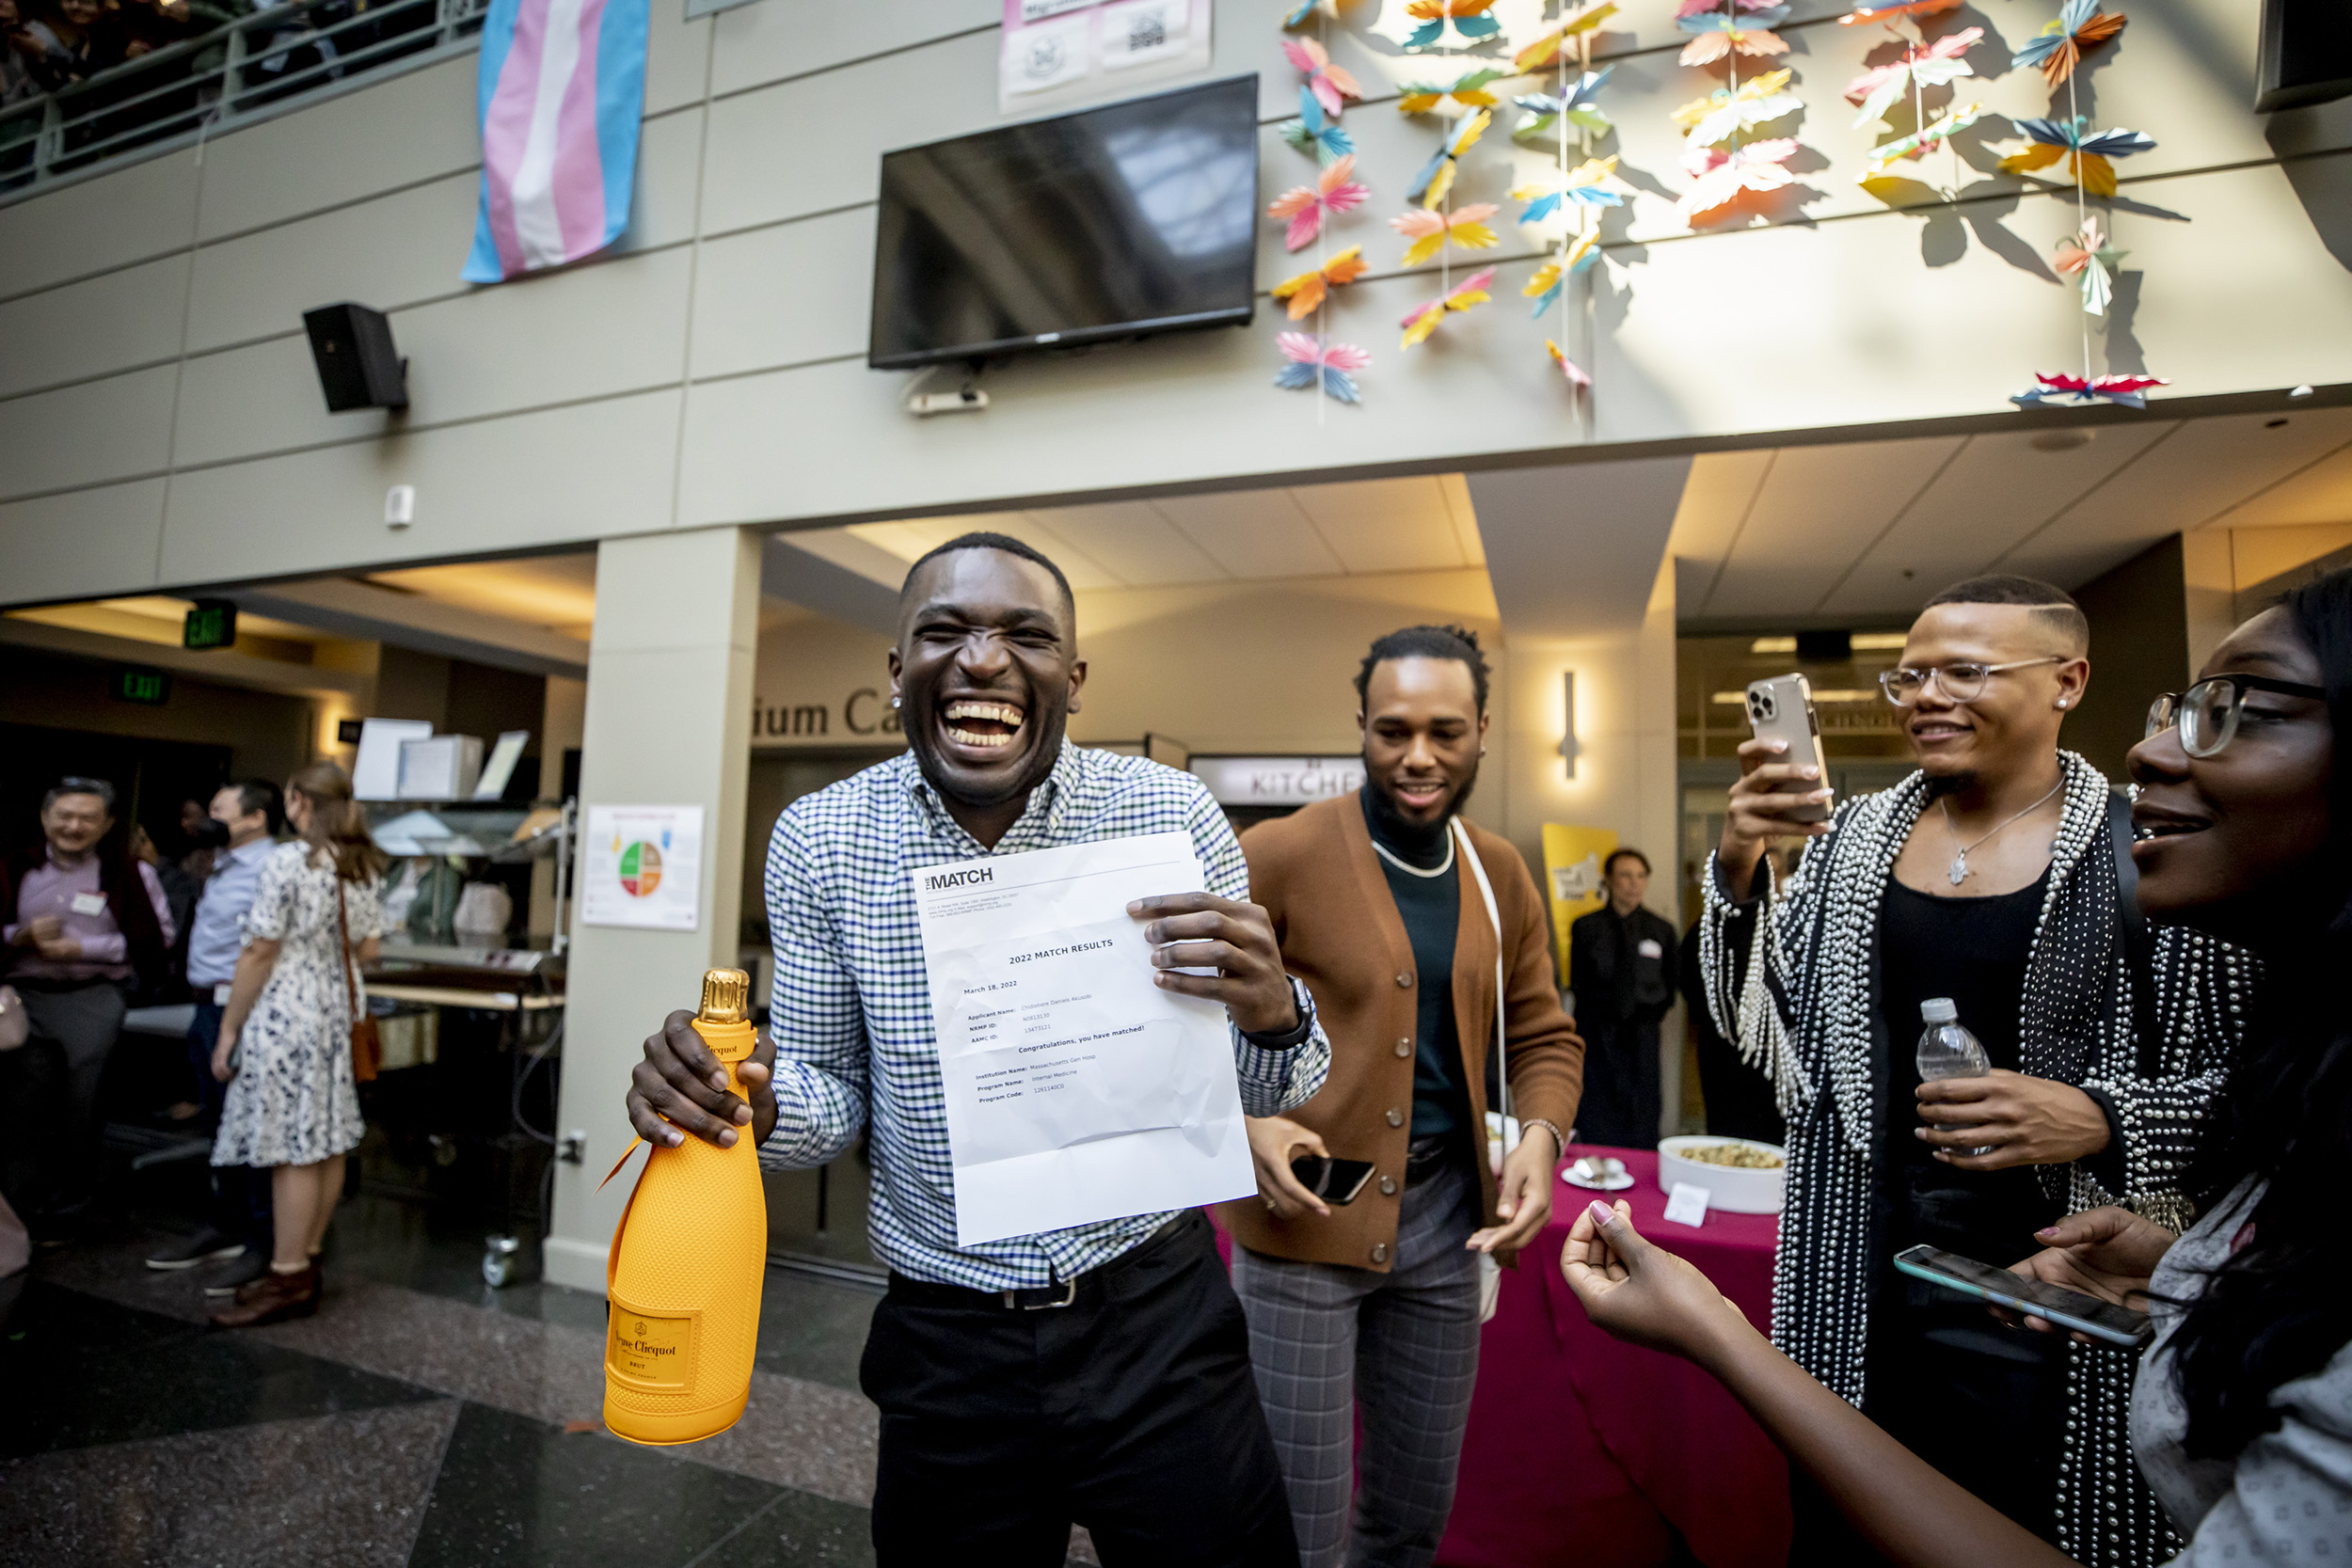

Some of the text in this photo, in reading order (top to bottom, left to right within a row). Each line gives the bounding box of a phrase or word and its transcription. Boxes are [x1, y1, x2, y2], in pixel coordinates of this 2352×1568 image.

[754, 688, 901, 736] ium Ca
[1250, 769, 1368, 796] KITCHE
[930, 867, 993, 890] MATCH
[1009, 939, 1114, 965] 2022 MATCH RESULTS
[963, 987, 986, 995] March
[1001, 980, 1017, 989] 2022
[967, 1011, 996, 1021] Applicant
[997, 1007, 1016, 1016] Name:
[969, 1024, 988, 1033] NRMP
[971, 1036, 989, 1044] AAMC
[1018, 1025, 1145, 1054] Congratulations, you have matched!
[976, 1053, 1097, 1081] Institution Name: Massachusetts Gen Hosp
[977, 1069, 1078, 1093] Program Name: Internal Medicine
[978, 1094, 1006, 1104] Program
[1006, 1090, 1025, 1100] Code:
[634, 1339, 675, 1357] Clicquot
[629, 1360, 645, 1370] BRUT
